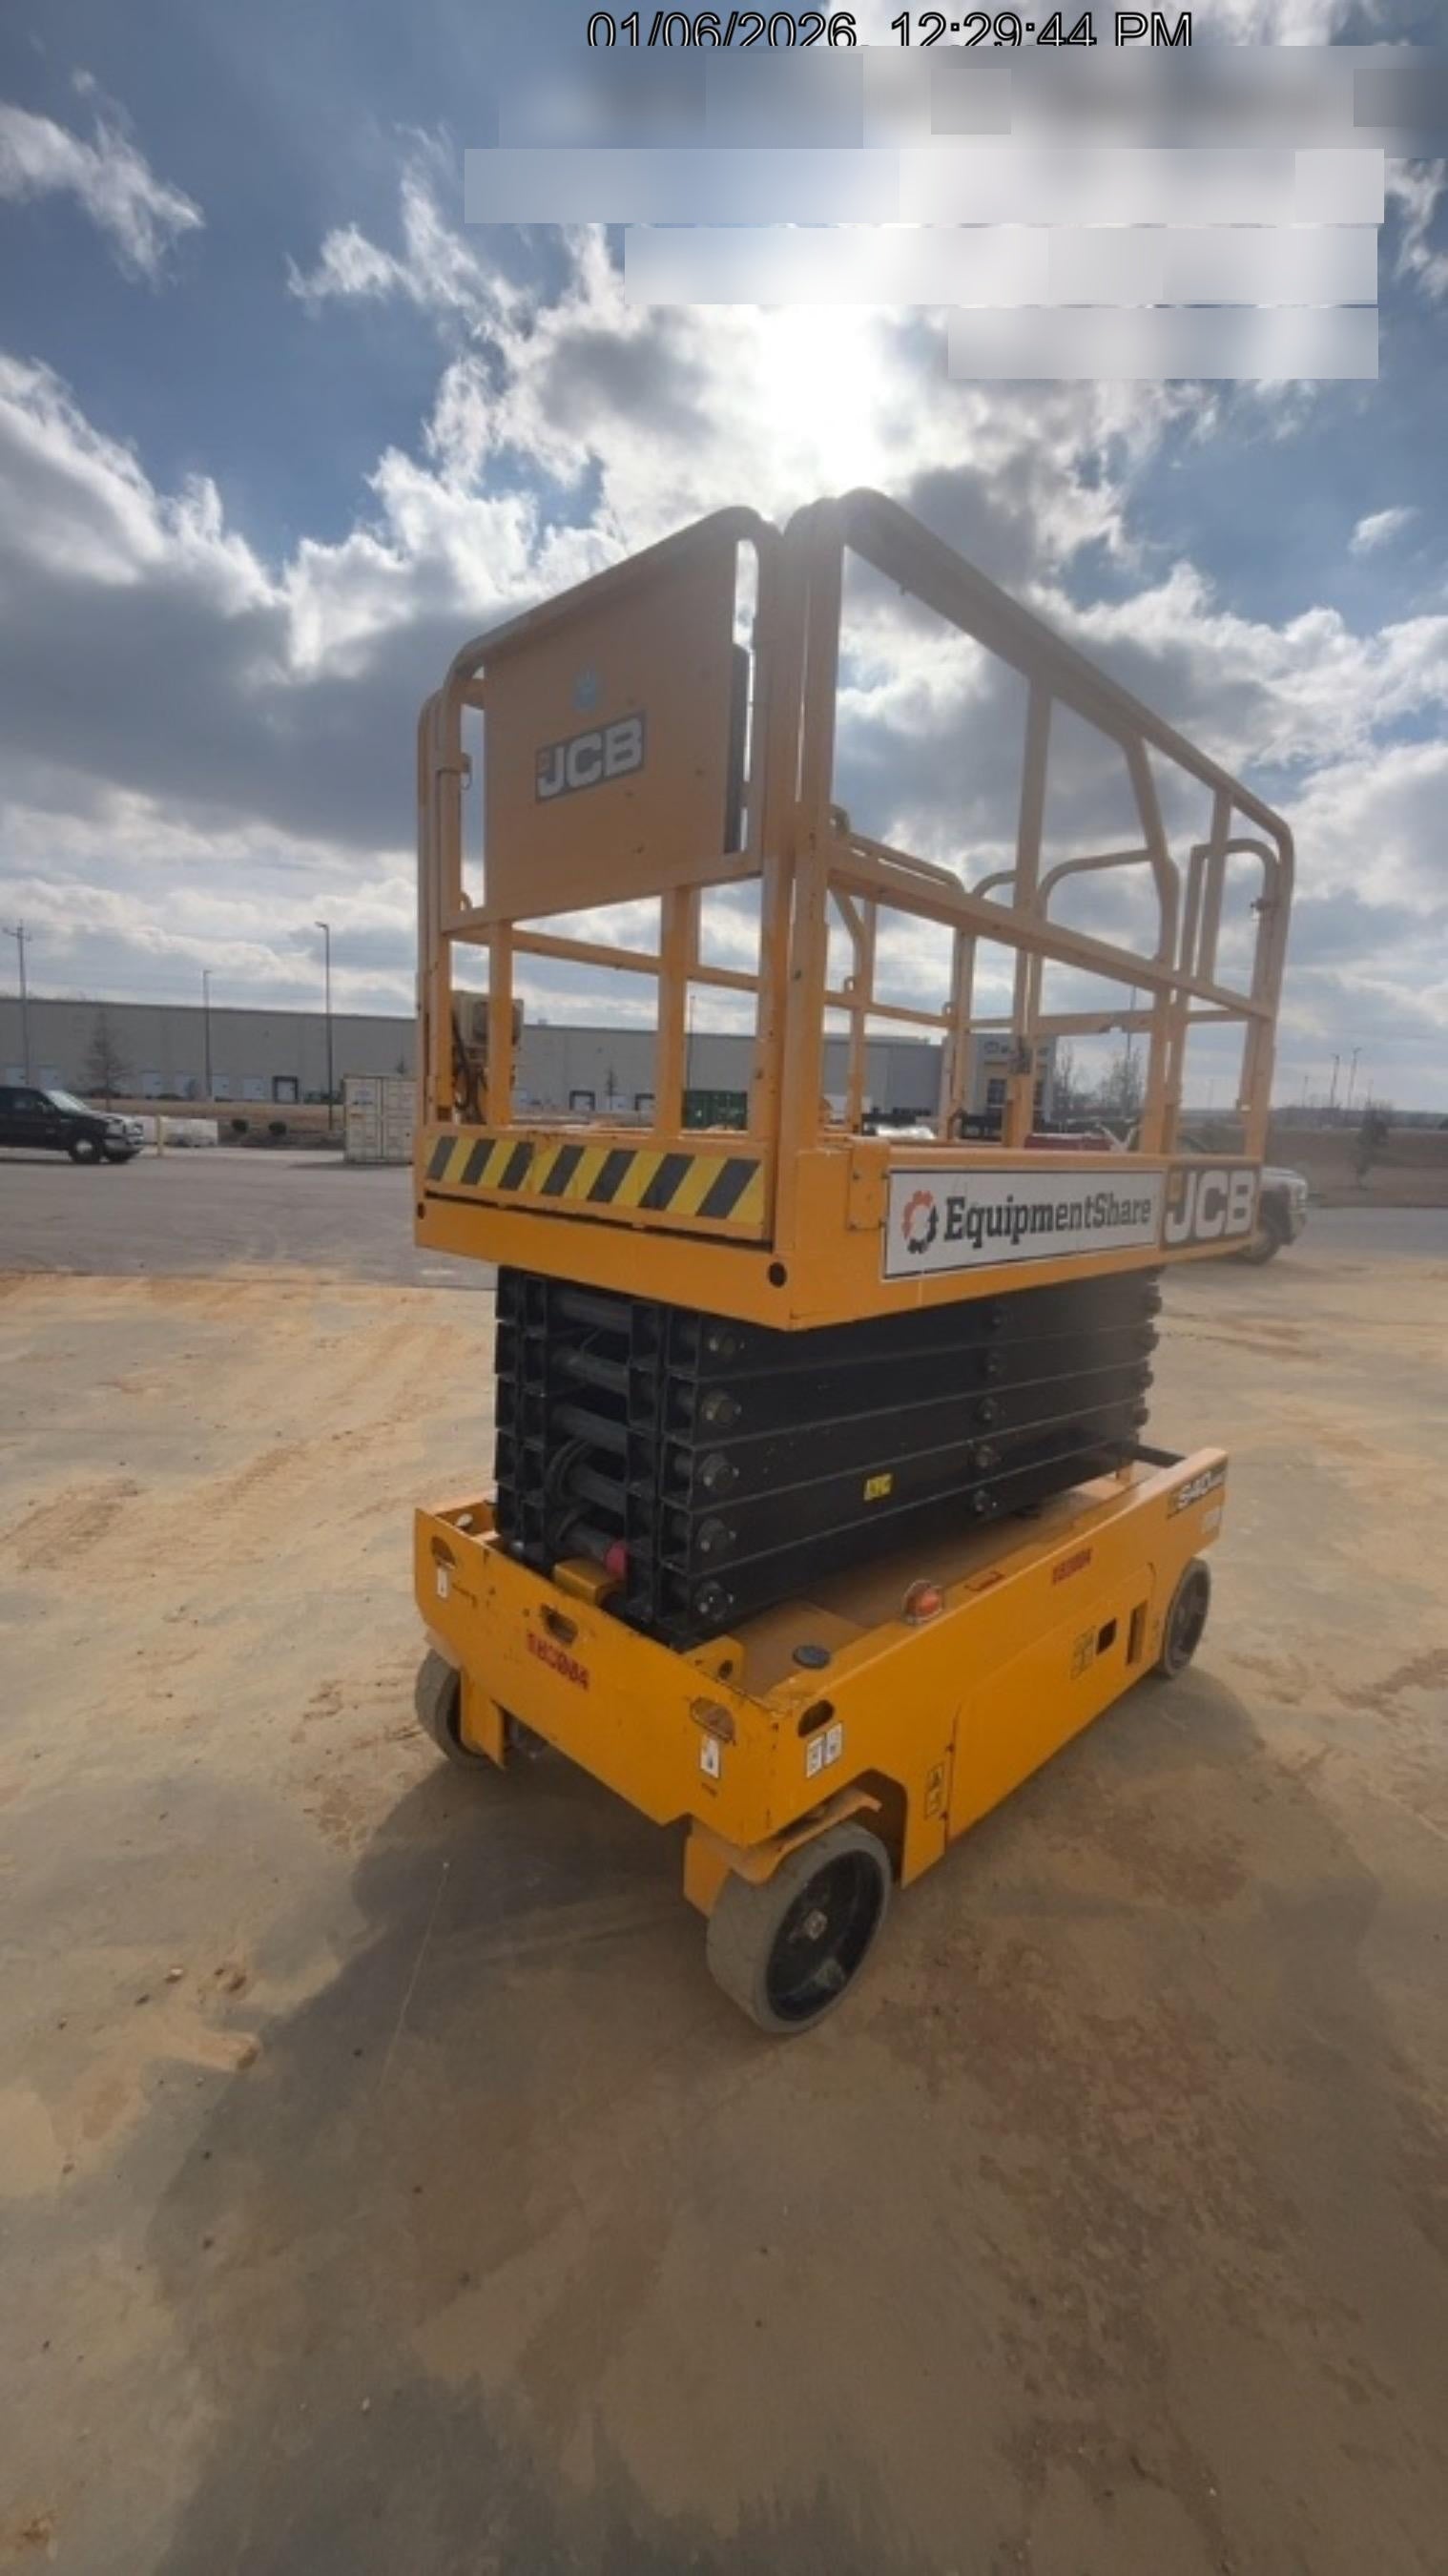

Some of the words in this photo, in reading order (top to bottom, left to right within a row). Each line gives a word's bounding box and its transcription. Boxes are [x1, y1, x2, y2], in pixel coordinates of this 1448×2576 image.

[536, 717, 643, 798] JCB
[942, 1192, 1151, 1249] EquipmentShare
[1166, 1170, 1256, 1244] JCB
